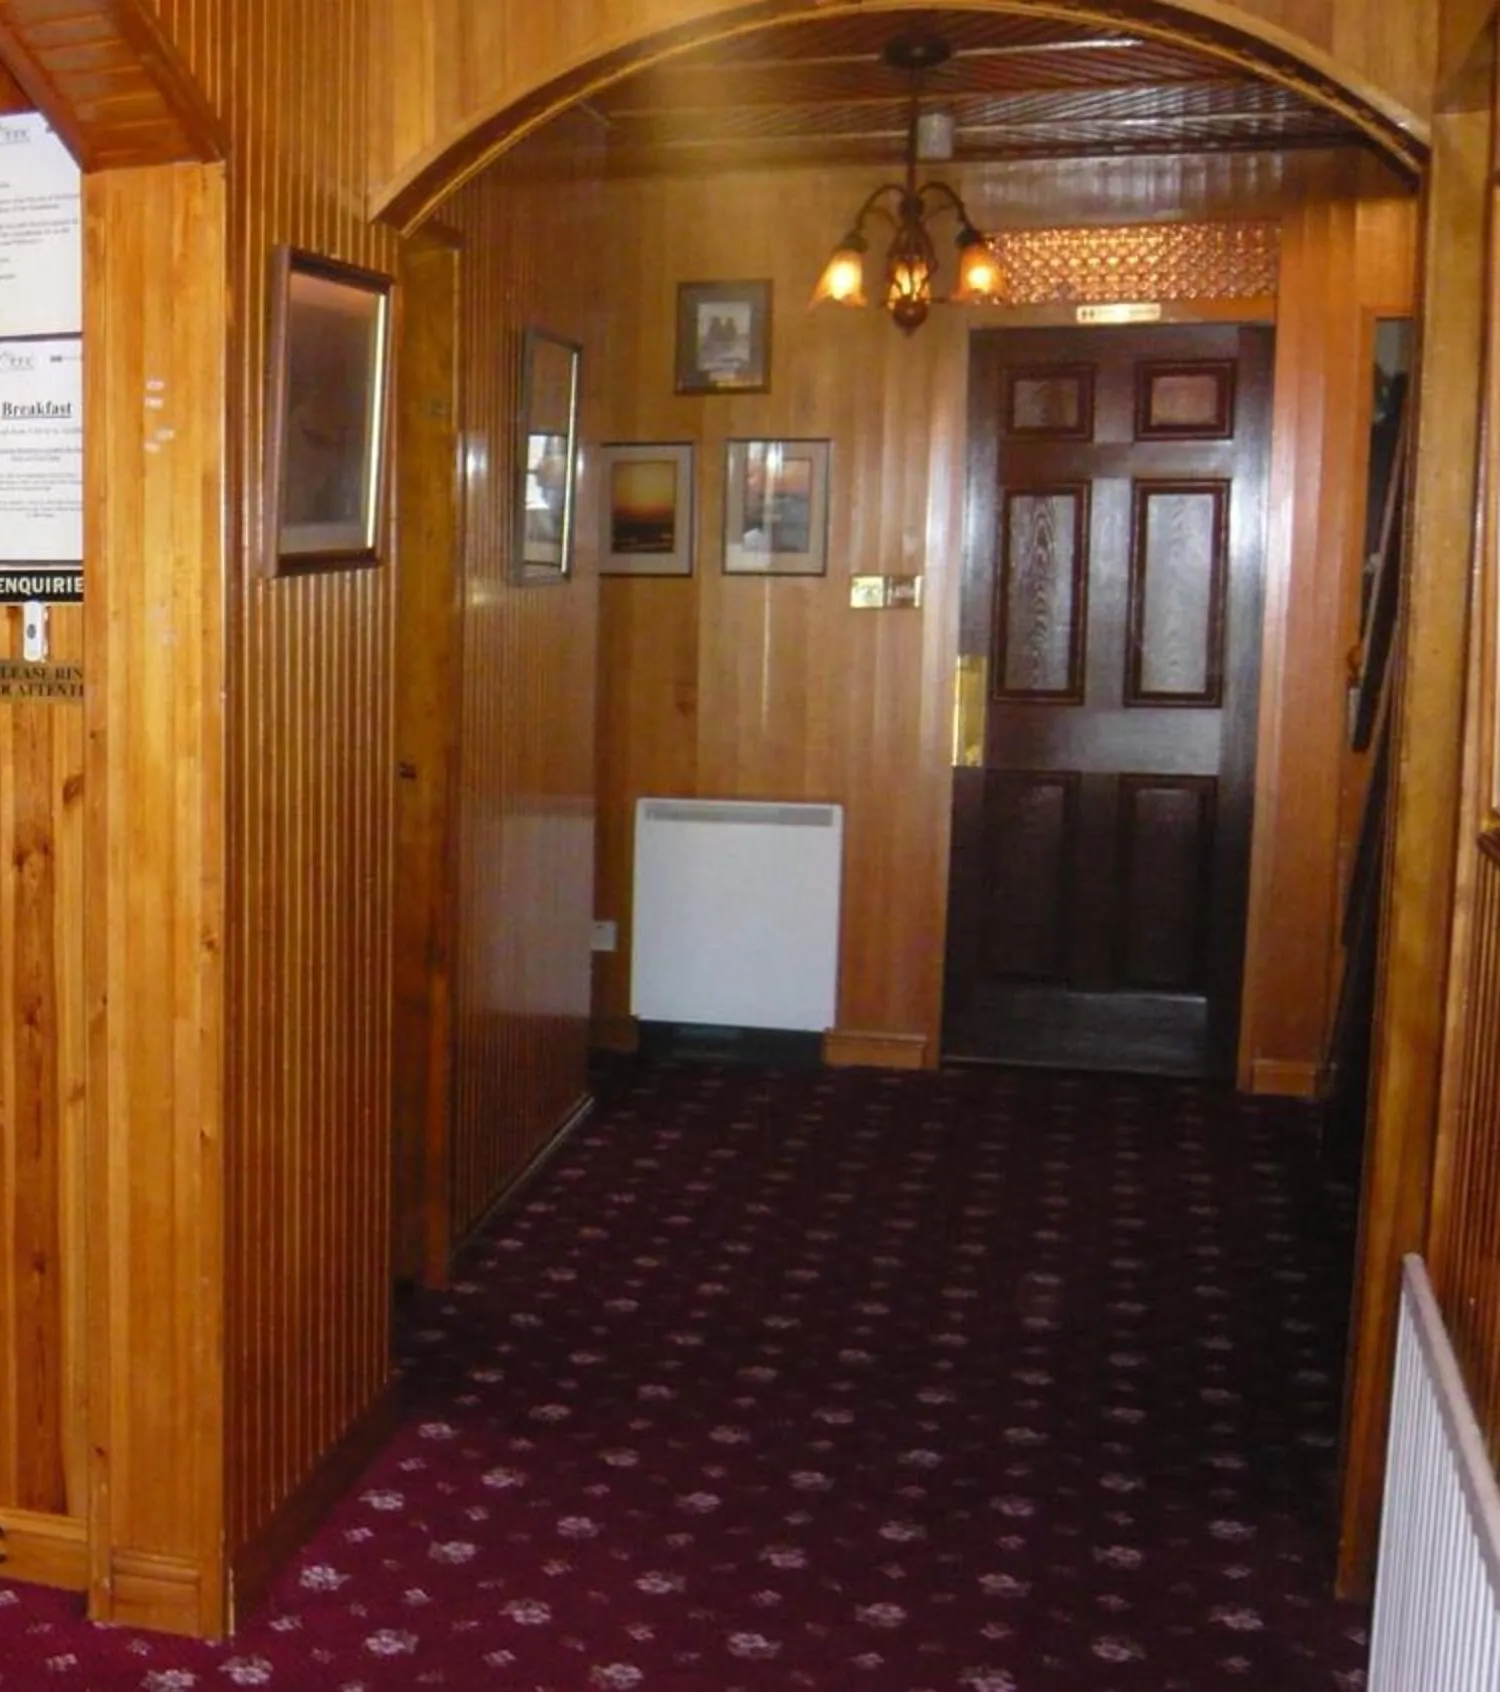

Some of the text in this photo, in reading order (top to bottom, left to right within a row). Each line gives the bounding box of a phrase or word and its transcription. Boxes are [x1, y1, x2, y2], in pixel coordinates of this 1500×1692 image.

[1, 400, 72, 417] Breakfast
[55, 666, 83, 680] RIN
[19, 682, 83, 697] ATTENTI
